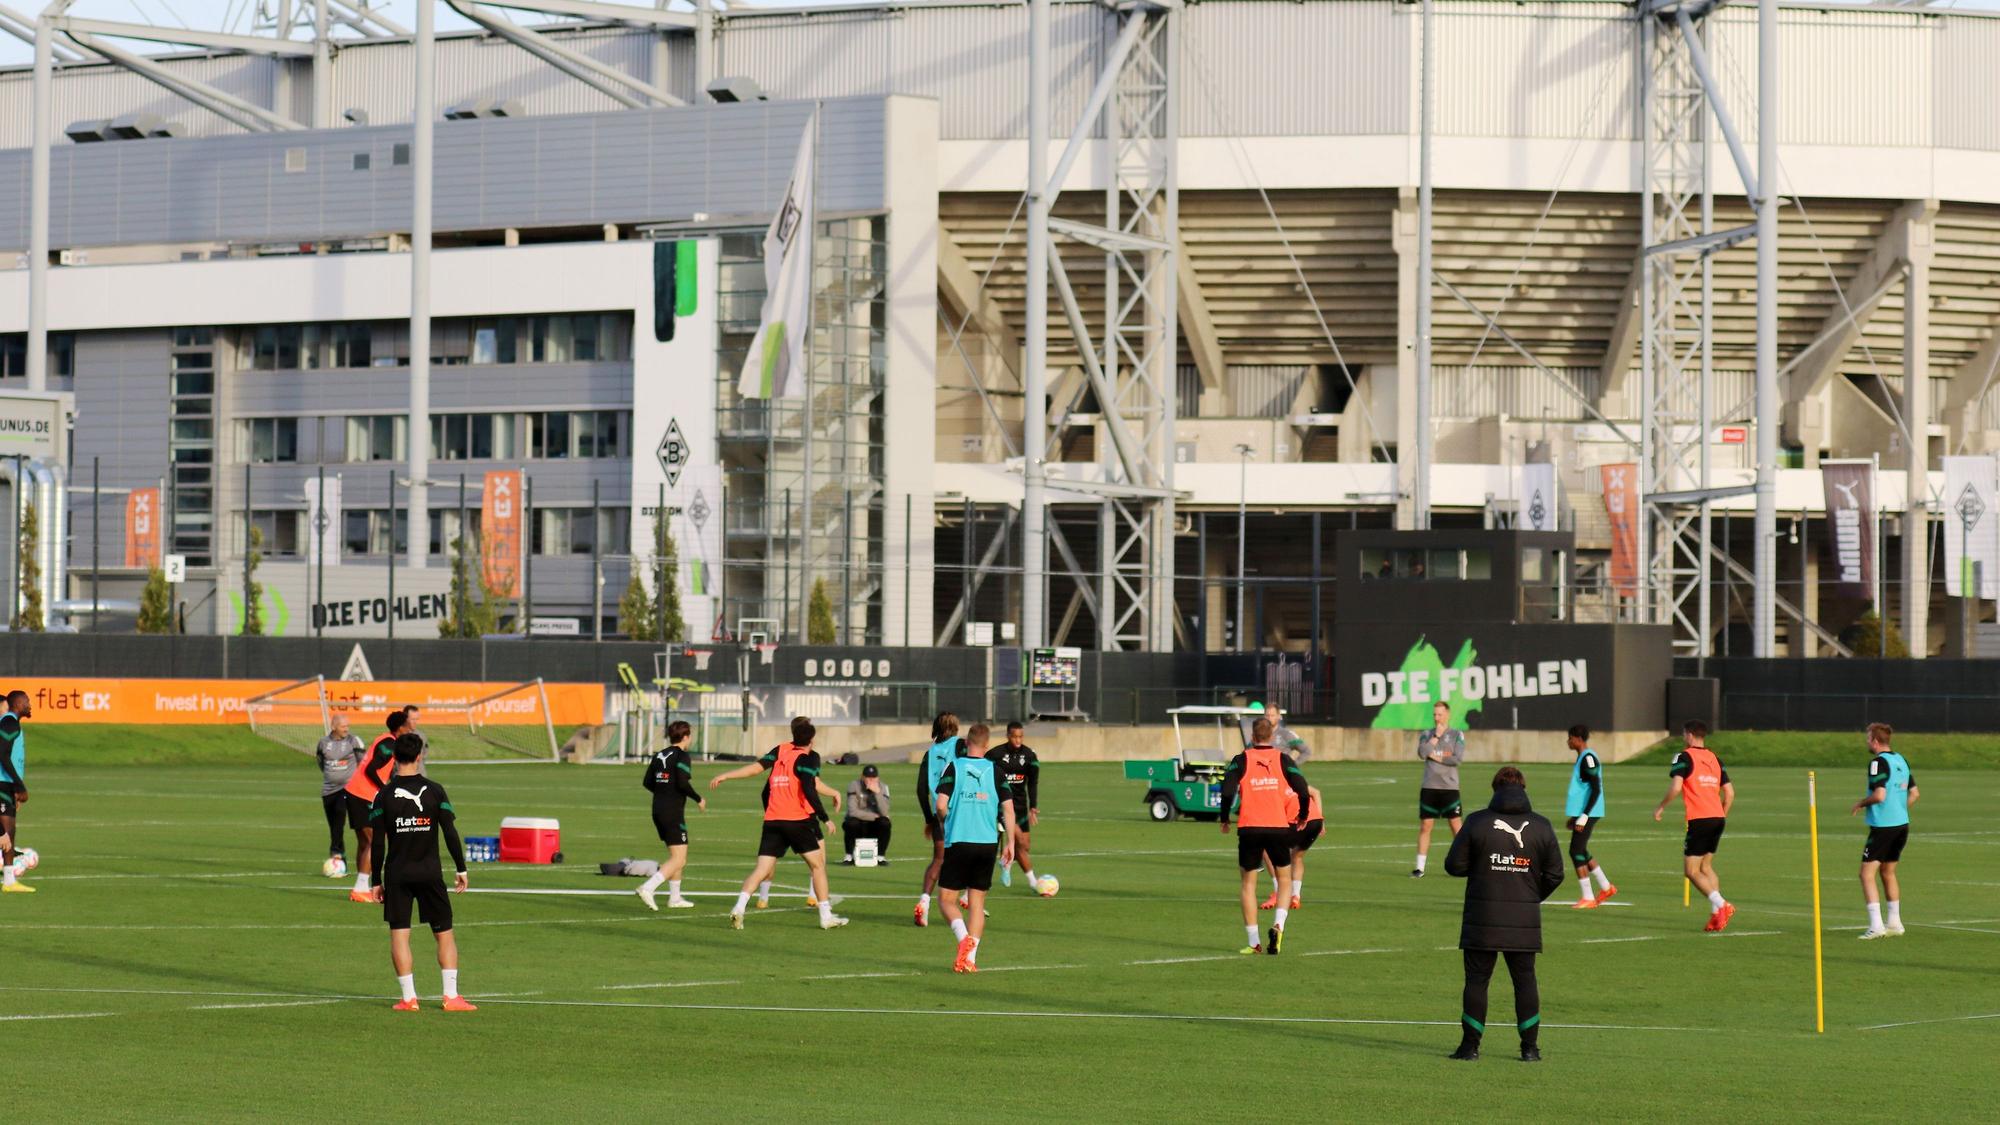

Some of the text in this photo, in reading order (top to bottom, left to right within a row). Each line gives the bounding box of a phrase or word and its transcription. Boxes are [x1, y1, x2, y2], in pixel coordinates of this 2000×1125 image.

[171, 562, 179, 575] 2
[312, 593, 447, 629] DIE FOHLEN
[1361, 658, 1589, 707] DIE FOHLEN
[155, 693, 198, 711] Invest
[202, 693, 214, 711] in
[784, 693, 832, 718] PUMA
